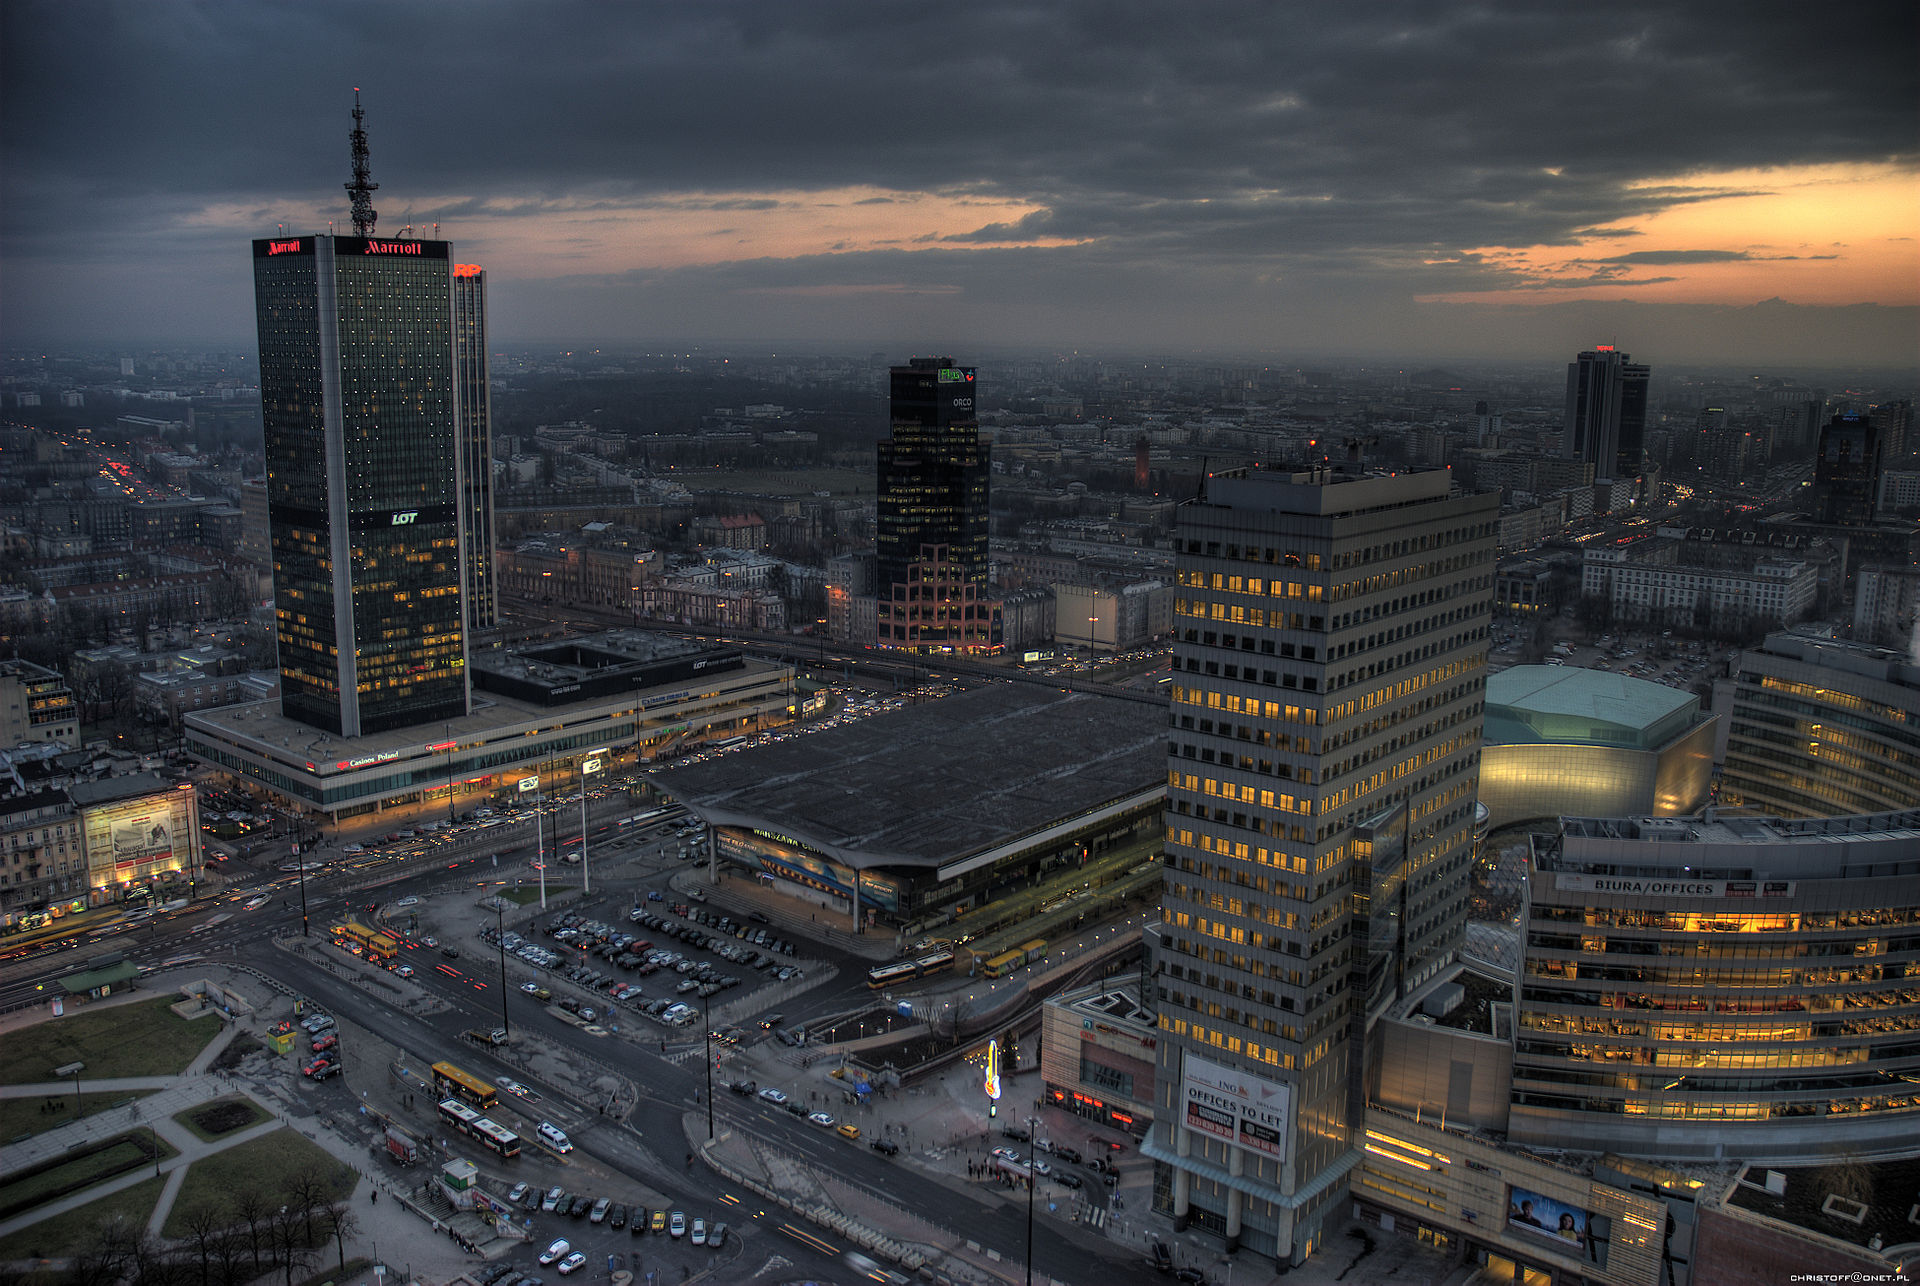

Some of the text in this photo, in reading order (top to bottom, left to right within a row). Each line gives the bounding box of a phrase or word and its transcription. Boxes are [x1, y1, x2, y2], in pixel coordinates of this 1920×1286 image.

[268, 240, 300, 256] Marriott
[365, 240, 421, 255] Marriott
[953, 398, 972, 407] ORCO
[392, 512, 418, 525] LOT
[350, 751, 399, 767] Casinos Poland
[1595, 879, 1713, 895] BIURA/OFFICES
[1219, 1080, 1237, 1093] ING
[1189, 1087, 1282, 1128] OFFICES TO LET
